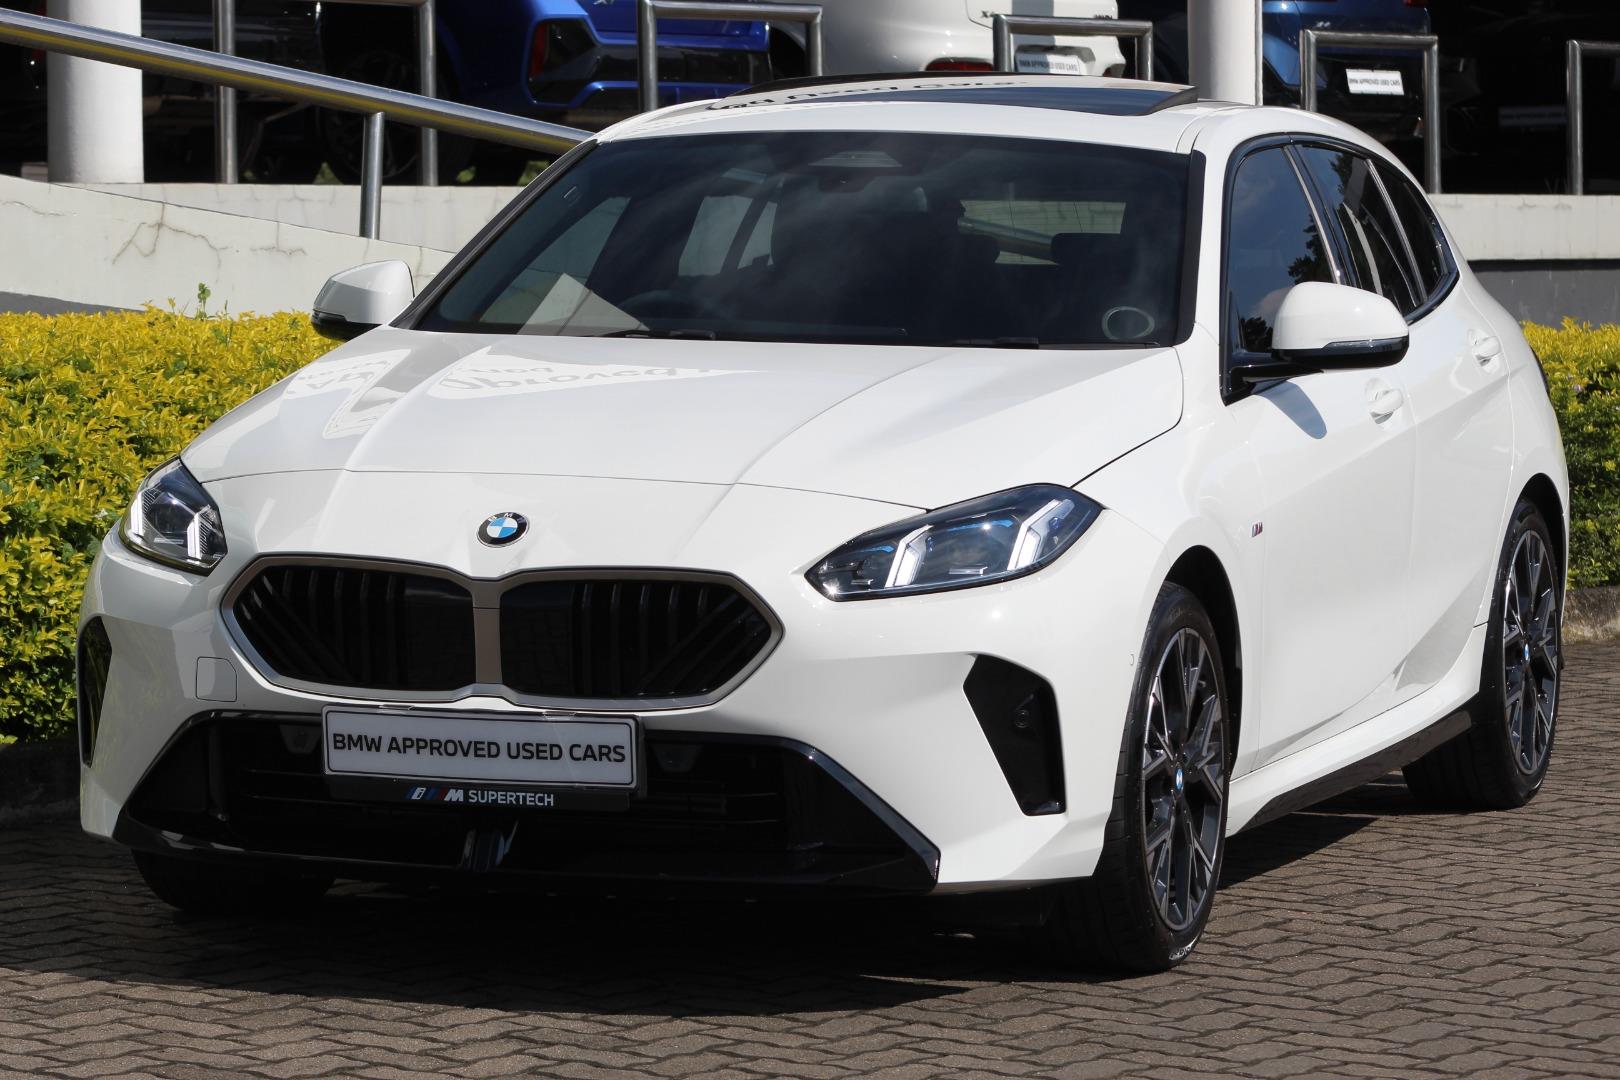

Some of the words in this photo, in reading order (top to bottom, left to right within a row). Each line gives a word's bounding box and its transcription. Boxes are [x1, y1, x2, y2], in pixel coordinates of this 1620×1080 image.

[333, 733, 382, 753] BMW
[387, 736, 500, 759] APPROVED
[506, 741, 563, 761] USED
[569, 743, 626, 763] CARS
[468, 789, 554, 807] SUPERTECH
